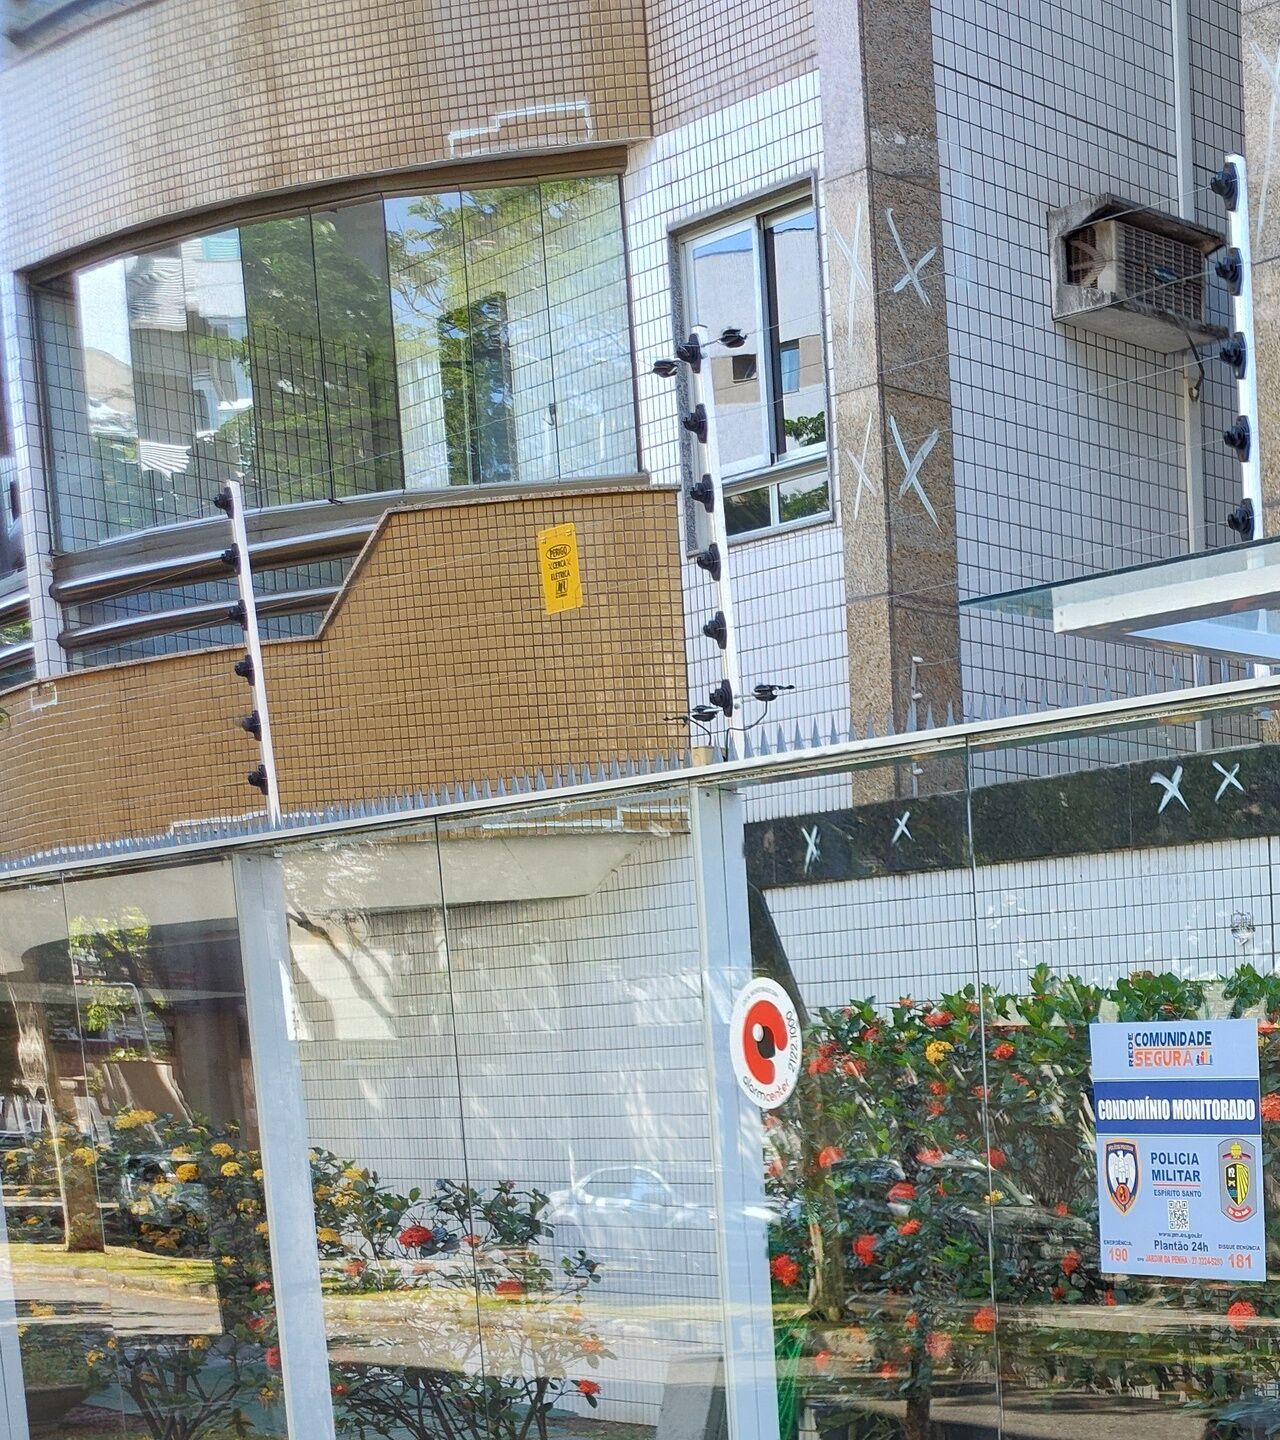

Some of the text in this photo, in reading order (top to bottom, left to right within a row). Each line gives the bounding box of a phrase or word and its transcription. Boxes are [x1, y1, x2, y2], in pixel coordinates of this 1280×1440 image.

[549, 546, 568, 557] PERIGO
[552, 560, 567, 569] CERCA
[1134, 1031, 1212, 1047] COMUNIDADE
[1134, 1050, 1194, 1068] SEGURA
[743, 1076, 789, 1102] alarmcenter
[1098, 1096, 1256, 1121] CONDOMÍNIO MONITORADO
[1151, 1169, 1201, 1182] MILITAR
[1182, 1189, 1202, 1198] SANTO
[1154, 1239, 1209, 1252] Plantão 24h
[1108, 1247, 1128, 1262] 190
[1228, 1253, 1253, 1269] 181
